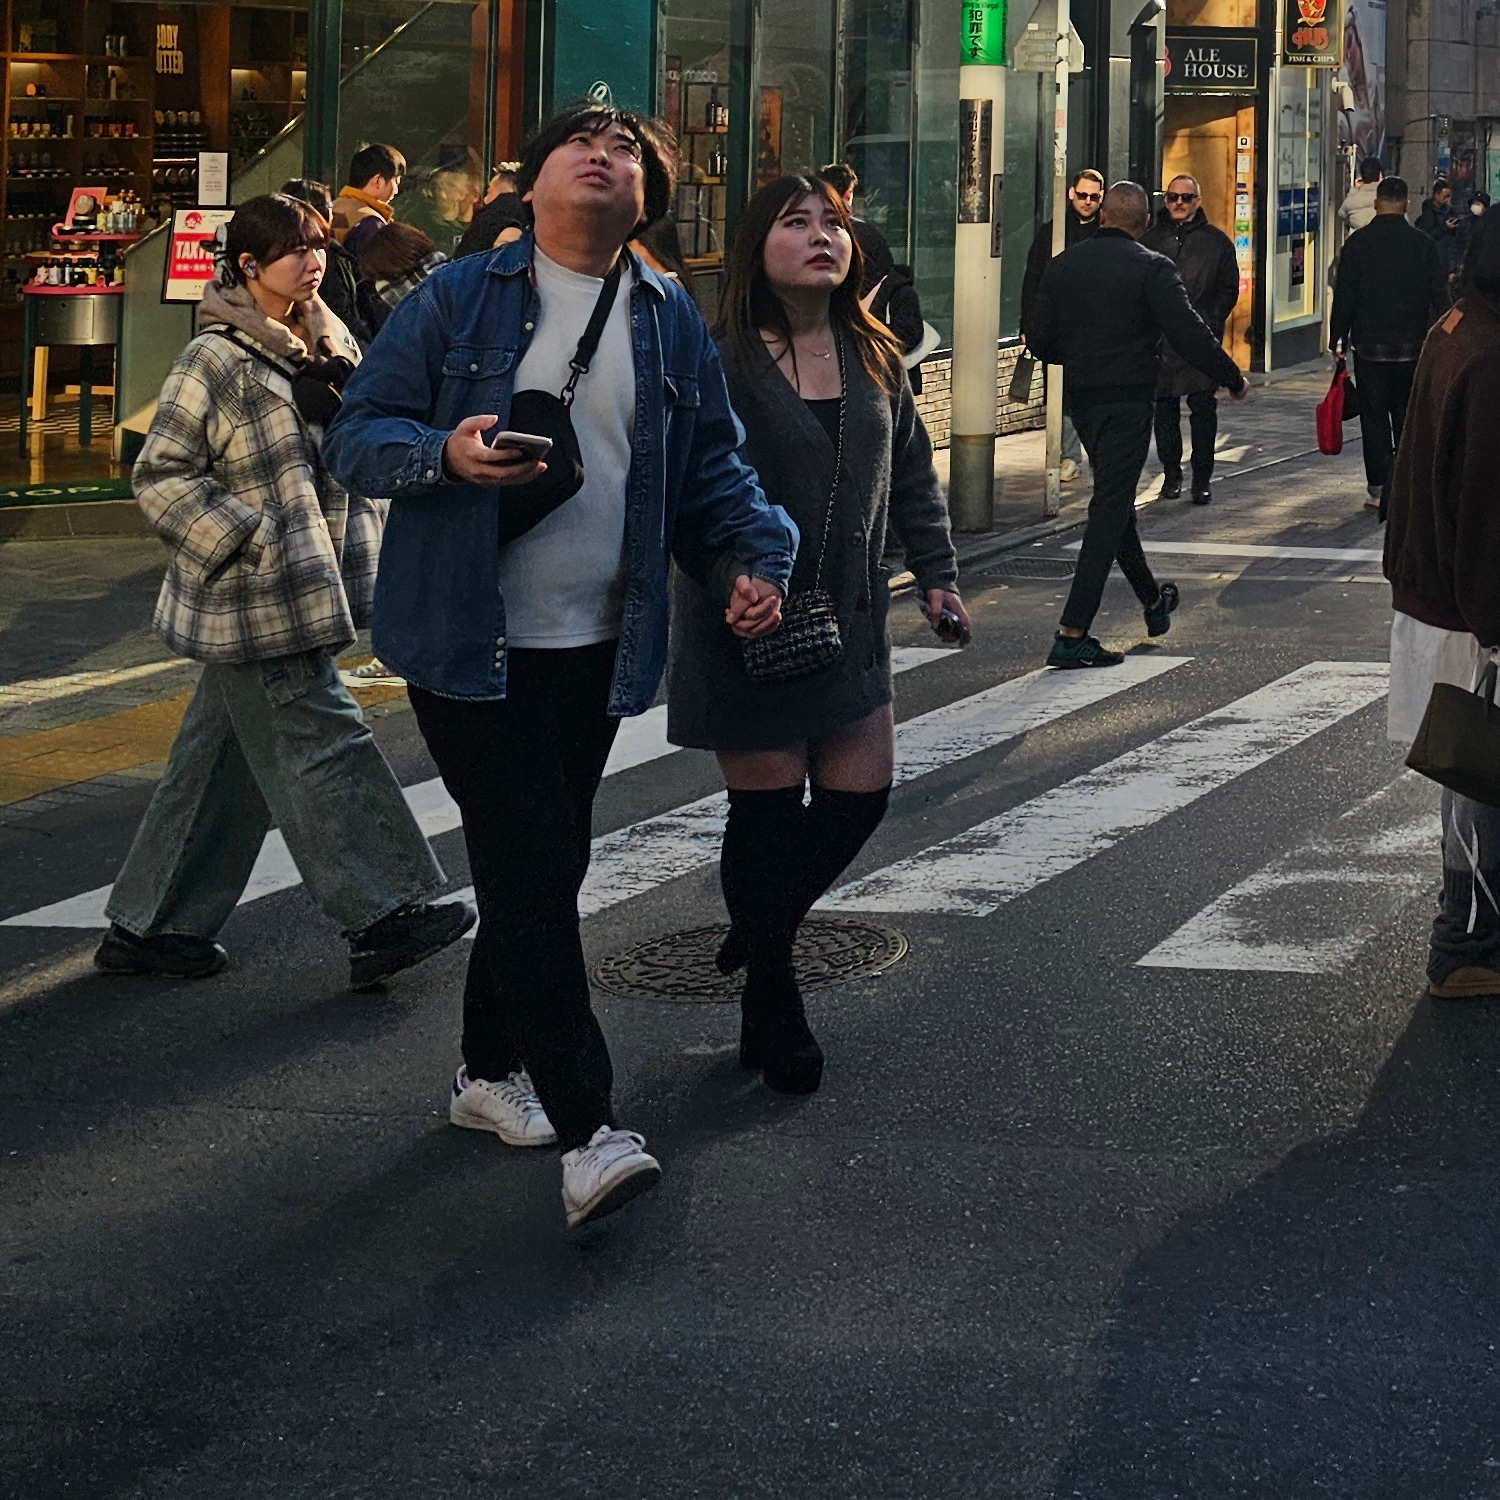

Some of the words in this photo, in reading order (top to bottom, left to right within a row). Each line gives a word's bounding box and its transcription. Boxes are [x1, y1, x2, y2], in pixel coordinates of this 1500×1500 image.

[156, 50, 183, 74] UTTER
[1184, 48, 1220, 62] ALE
[1184, 64, 1248, 78] HOUSE
